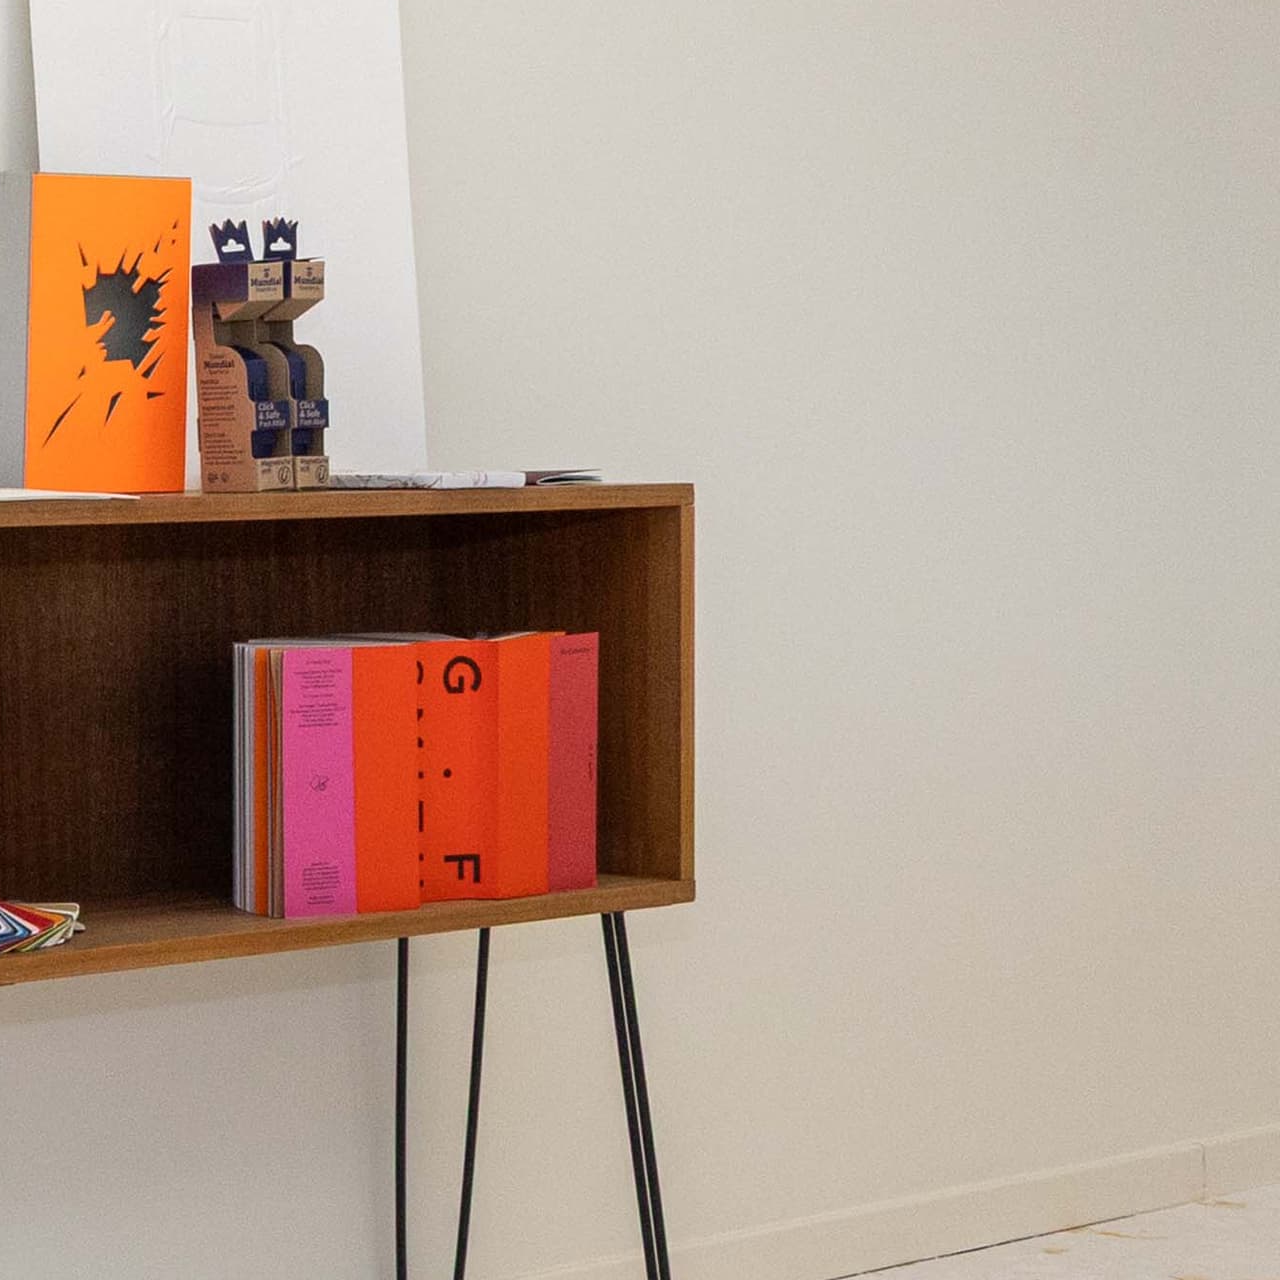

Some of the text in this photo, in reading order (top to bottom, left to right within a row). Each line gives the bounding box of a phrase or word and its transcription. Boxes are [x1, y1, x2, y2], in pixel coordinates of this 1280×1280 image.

[250, 276, 282, 287] Mundial
[203, 359, 236, 369] Mundial
[257, 402, 274, 411] Click
[299, 400, 315, 410] Click
